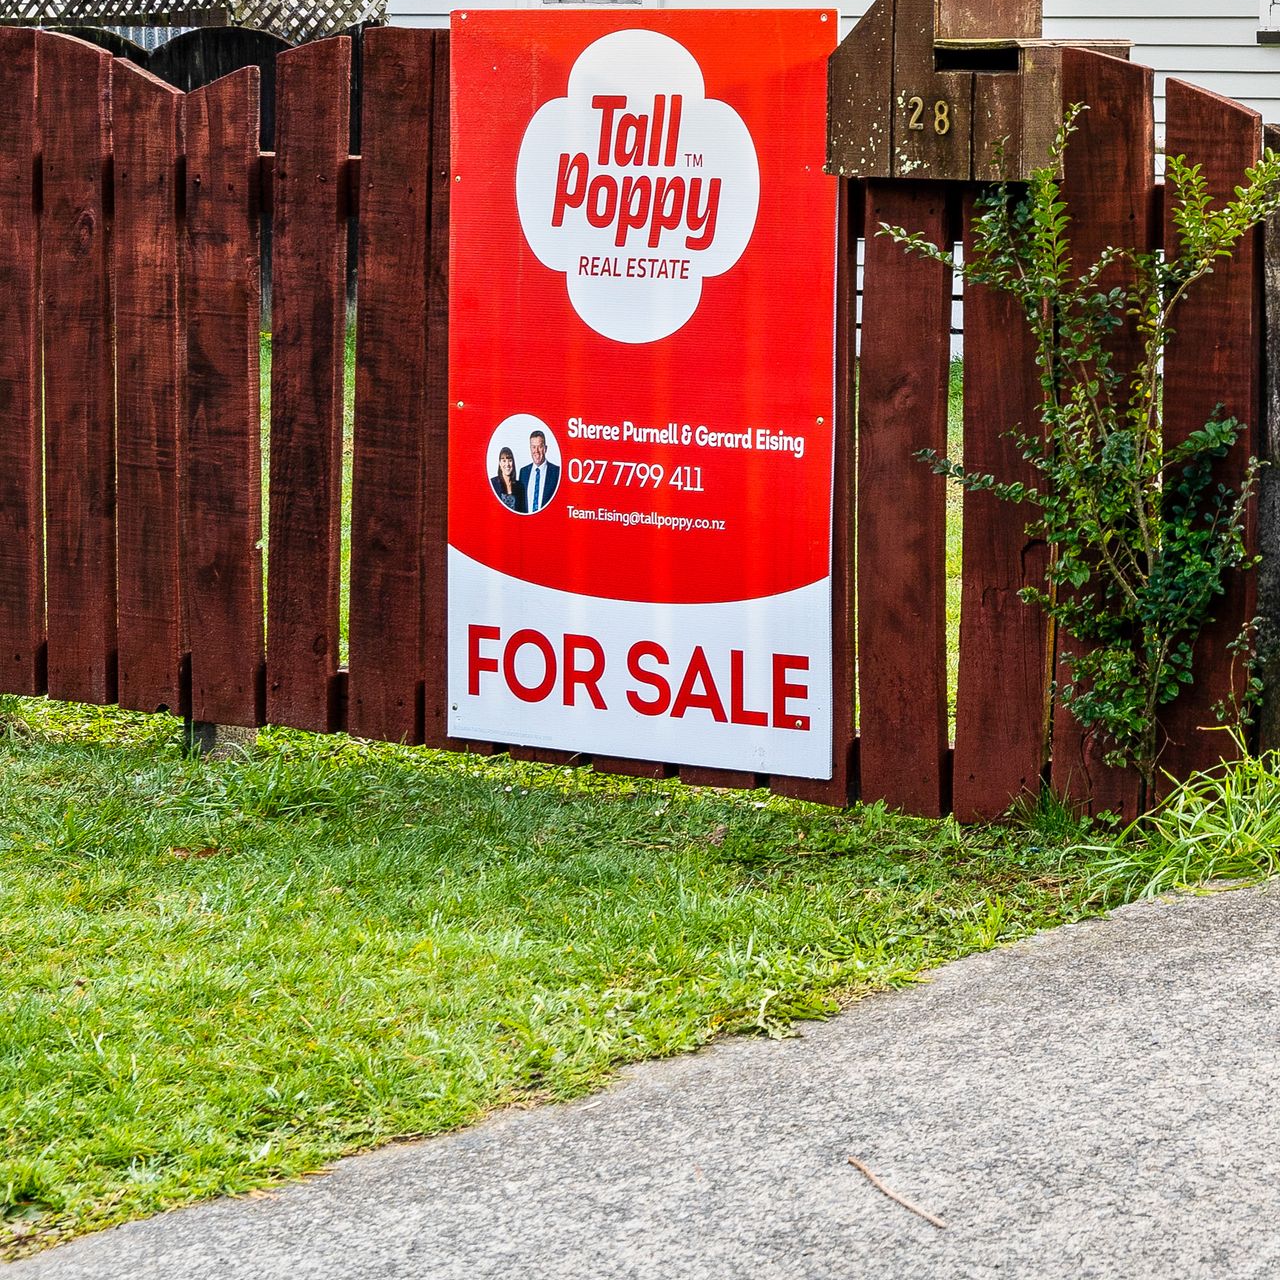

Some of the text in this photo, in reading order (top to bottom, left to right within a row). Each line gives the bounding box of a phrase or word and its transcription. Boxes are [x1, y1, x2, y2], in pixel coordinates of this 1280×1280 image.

[591, 94, 703, 168] Tall TM
[908, 96, 950, 135] 28
[578, 256, 691, 279] REAL ESTATE
[567, 417, 805, 458] Sheree Purnell & Gerard Eising
[568, 458, 704, 492] 027 7799 411
[567, 505, 726, 531] Team.Eising@tallpoppy.co.nz
[468, 623, 811, 731] FOR SALE
